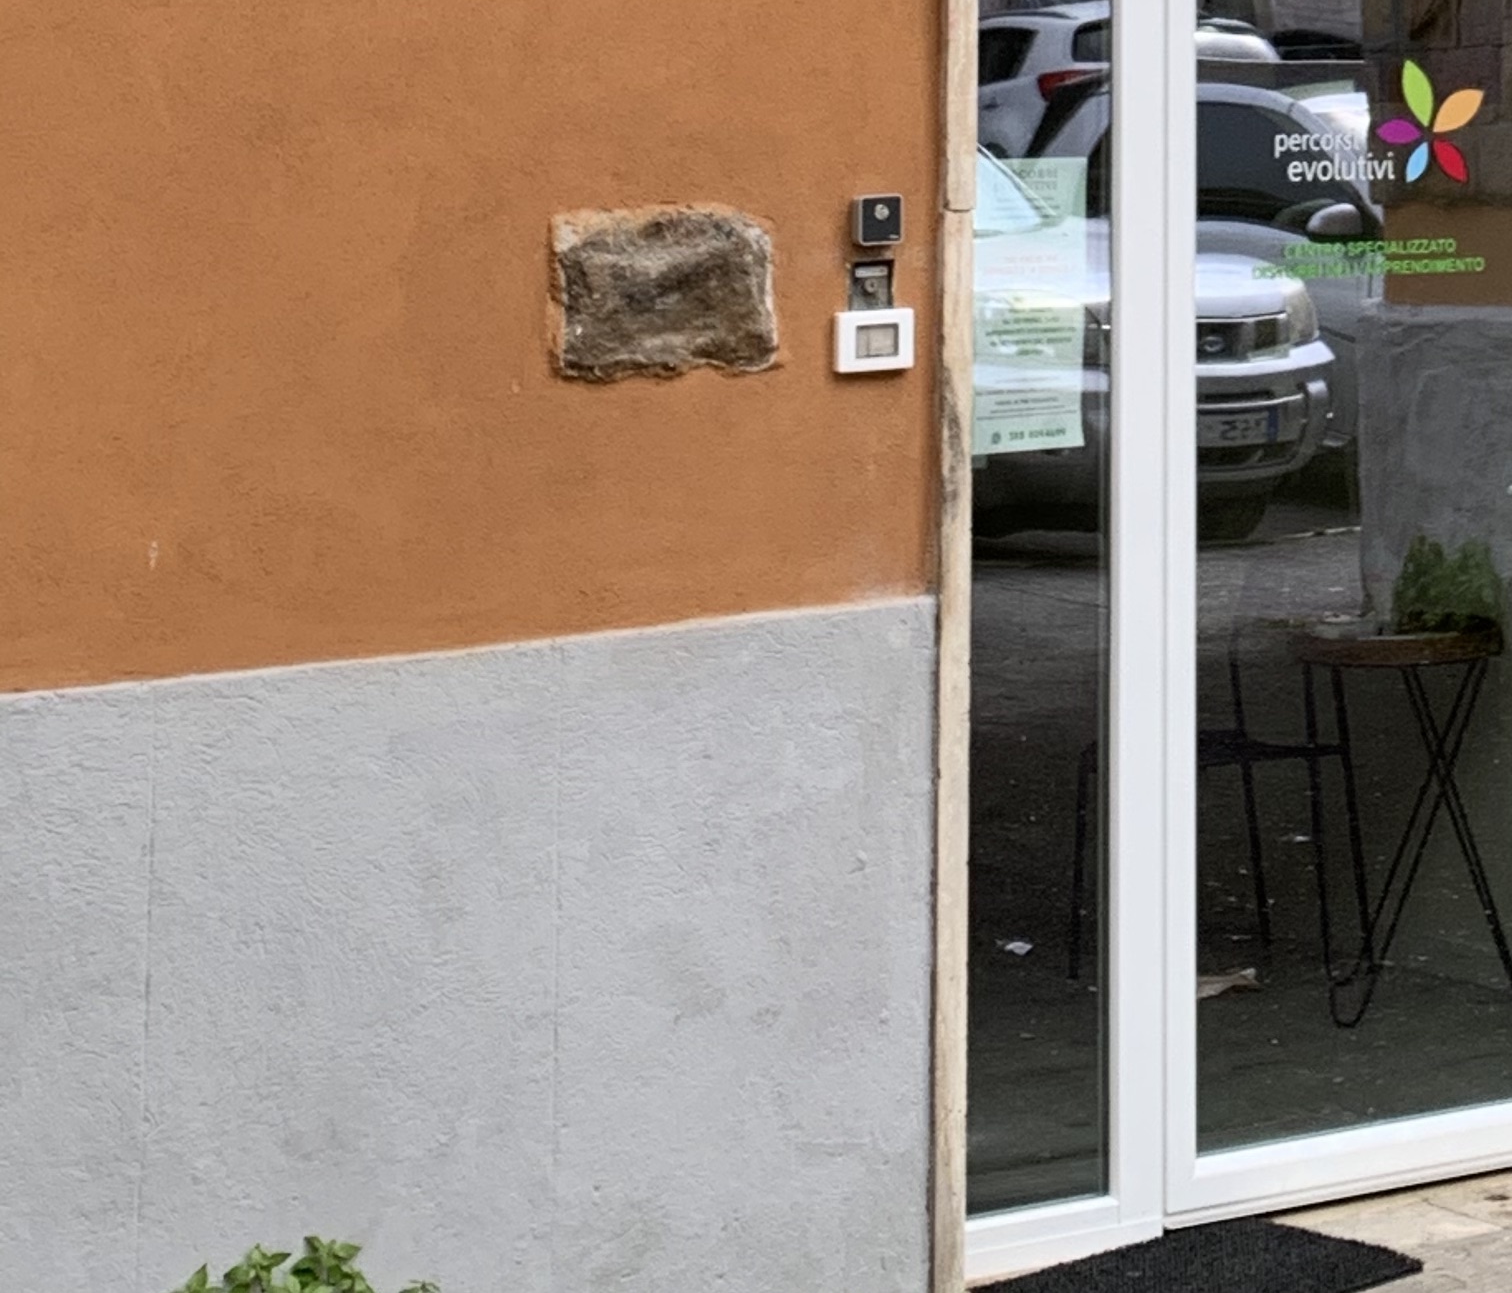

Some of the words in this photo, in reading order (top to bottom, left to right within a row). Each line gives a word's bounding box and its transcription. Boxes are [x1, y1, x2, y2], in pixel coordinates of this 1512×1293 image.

[1274, 130, 1361, 159] percorsi
[1287, 151, 1396, 182] evolutivi
[1347, 238, 1456, 257] SPECIALIZZATO
